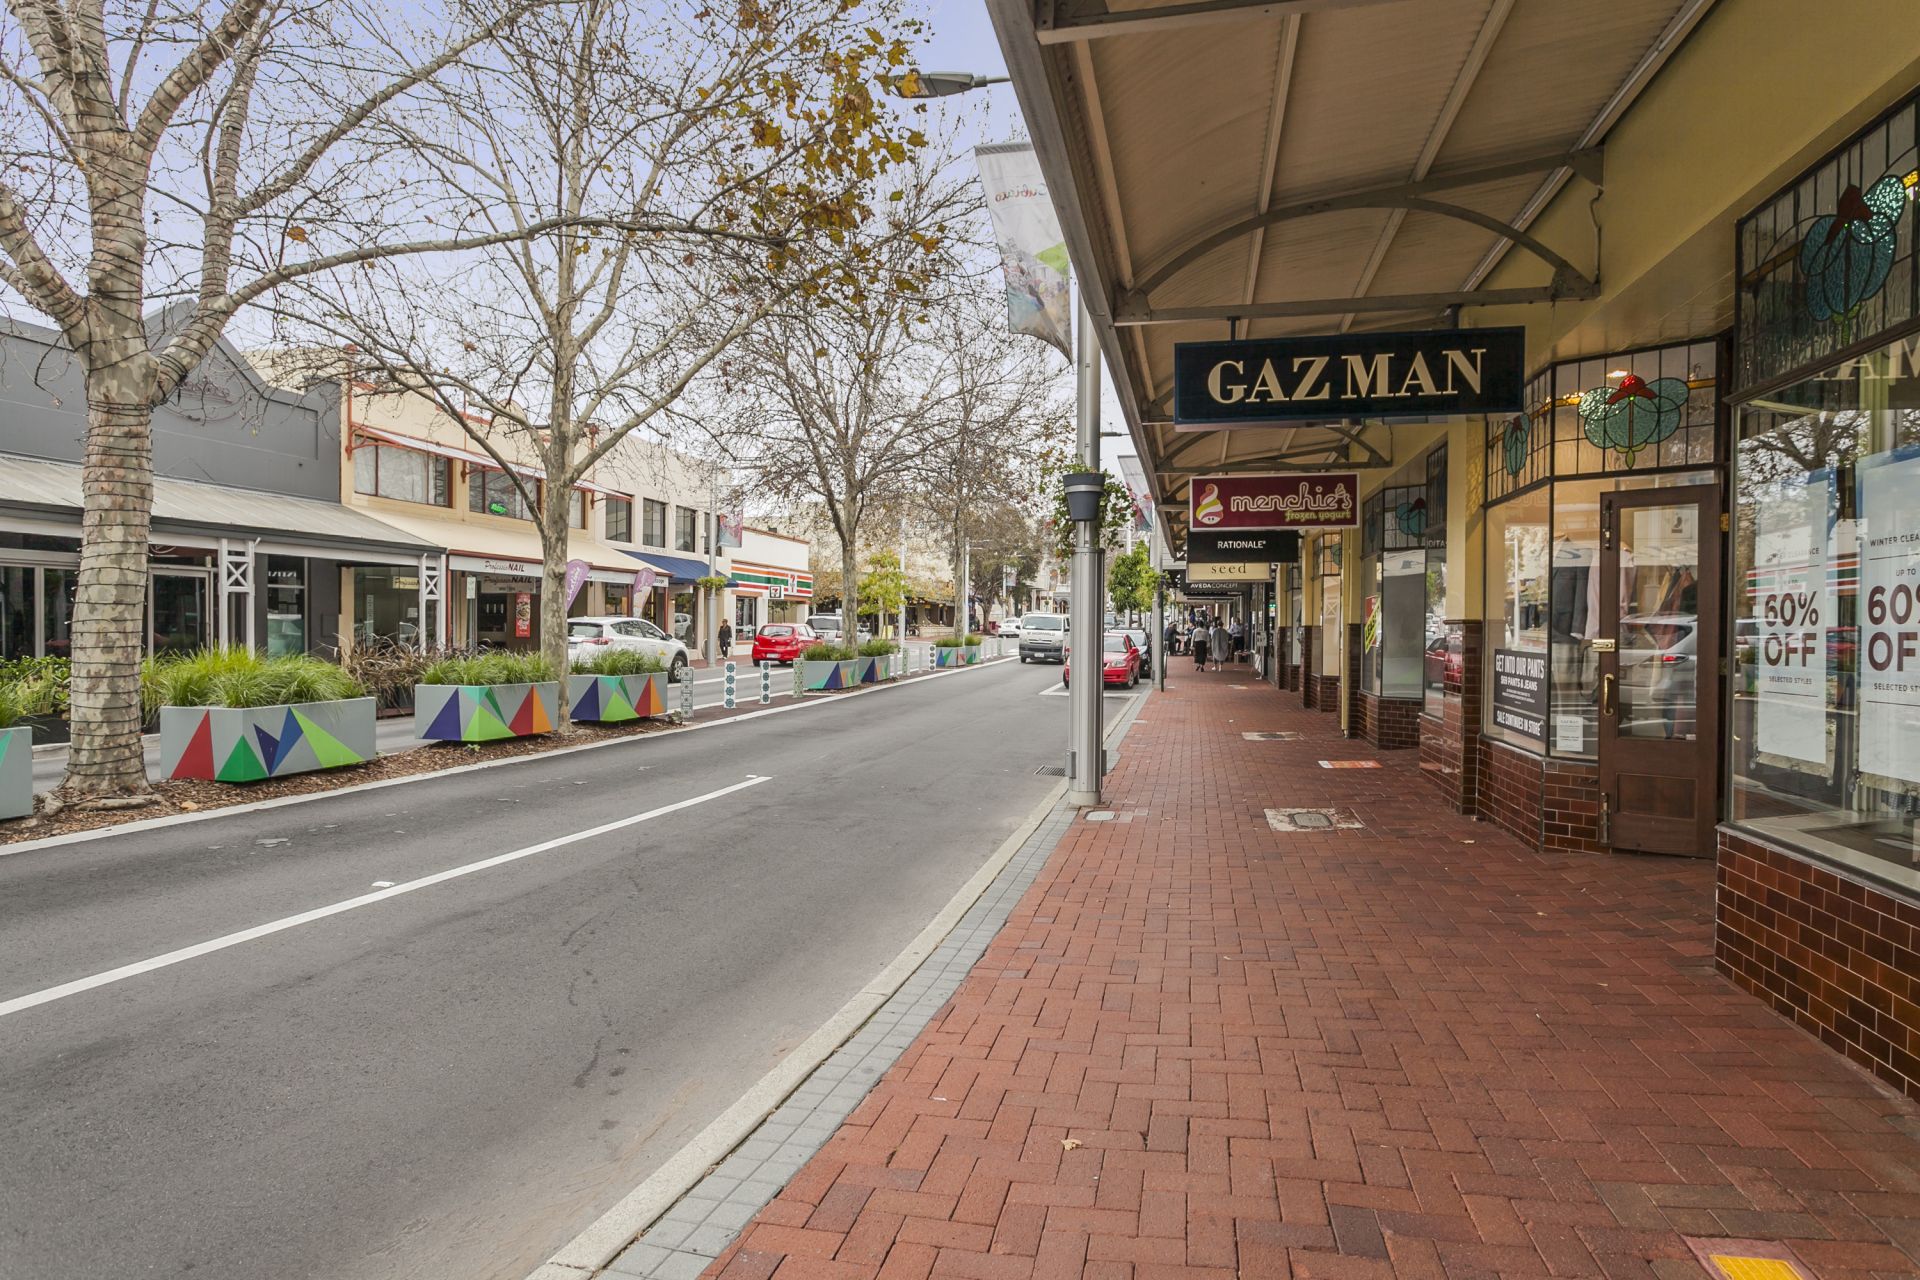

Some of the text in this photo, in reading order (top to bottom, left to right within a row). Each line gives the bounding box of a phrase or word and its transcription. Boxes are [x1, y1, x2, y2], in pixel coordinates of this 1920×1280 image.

[1231, 482, 1353, 512] menchie's
[1285, 508, 1352, 522] frozen yogurt
[1870, 537, 1898, 547] WINTER
[1211, 562, 1247, 574] seed
[1907, 568, 1917, 576] TO
[1764, 590, 1819, 627] 60%
[1868, 584, 1920, 625] 60
[1764, 632, 1817, 667] OFF
[1495, 654, 1545, 679] GET INTO OUR PANTS
[1508, 676, 1520, 688] PANTS
[1524, 680, 1538, 691] JEANS
[1768, 676, 1813, 685] SELECTED STYLES
[1873, 682, 1908, 692] SELECTED
[1496, 710, 1541, 736] SALE CONTINUES IN STORE
